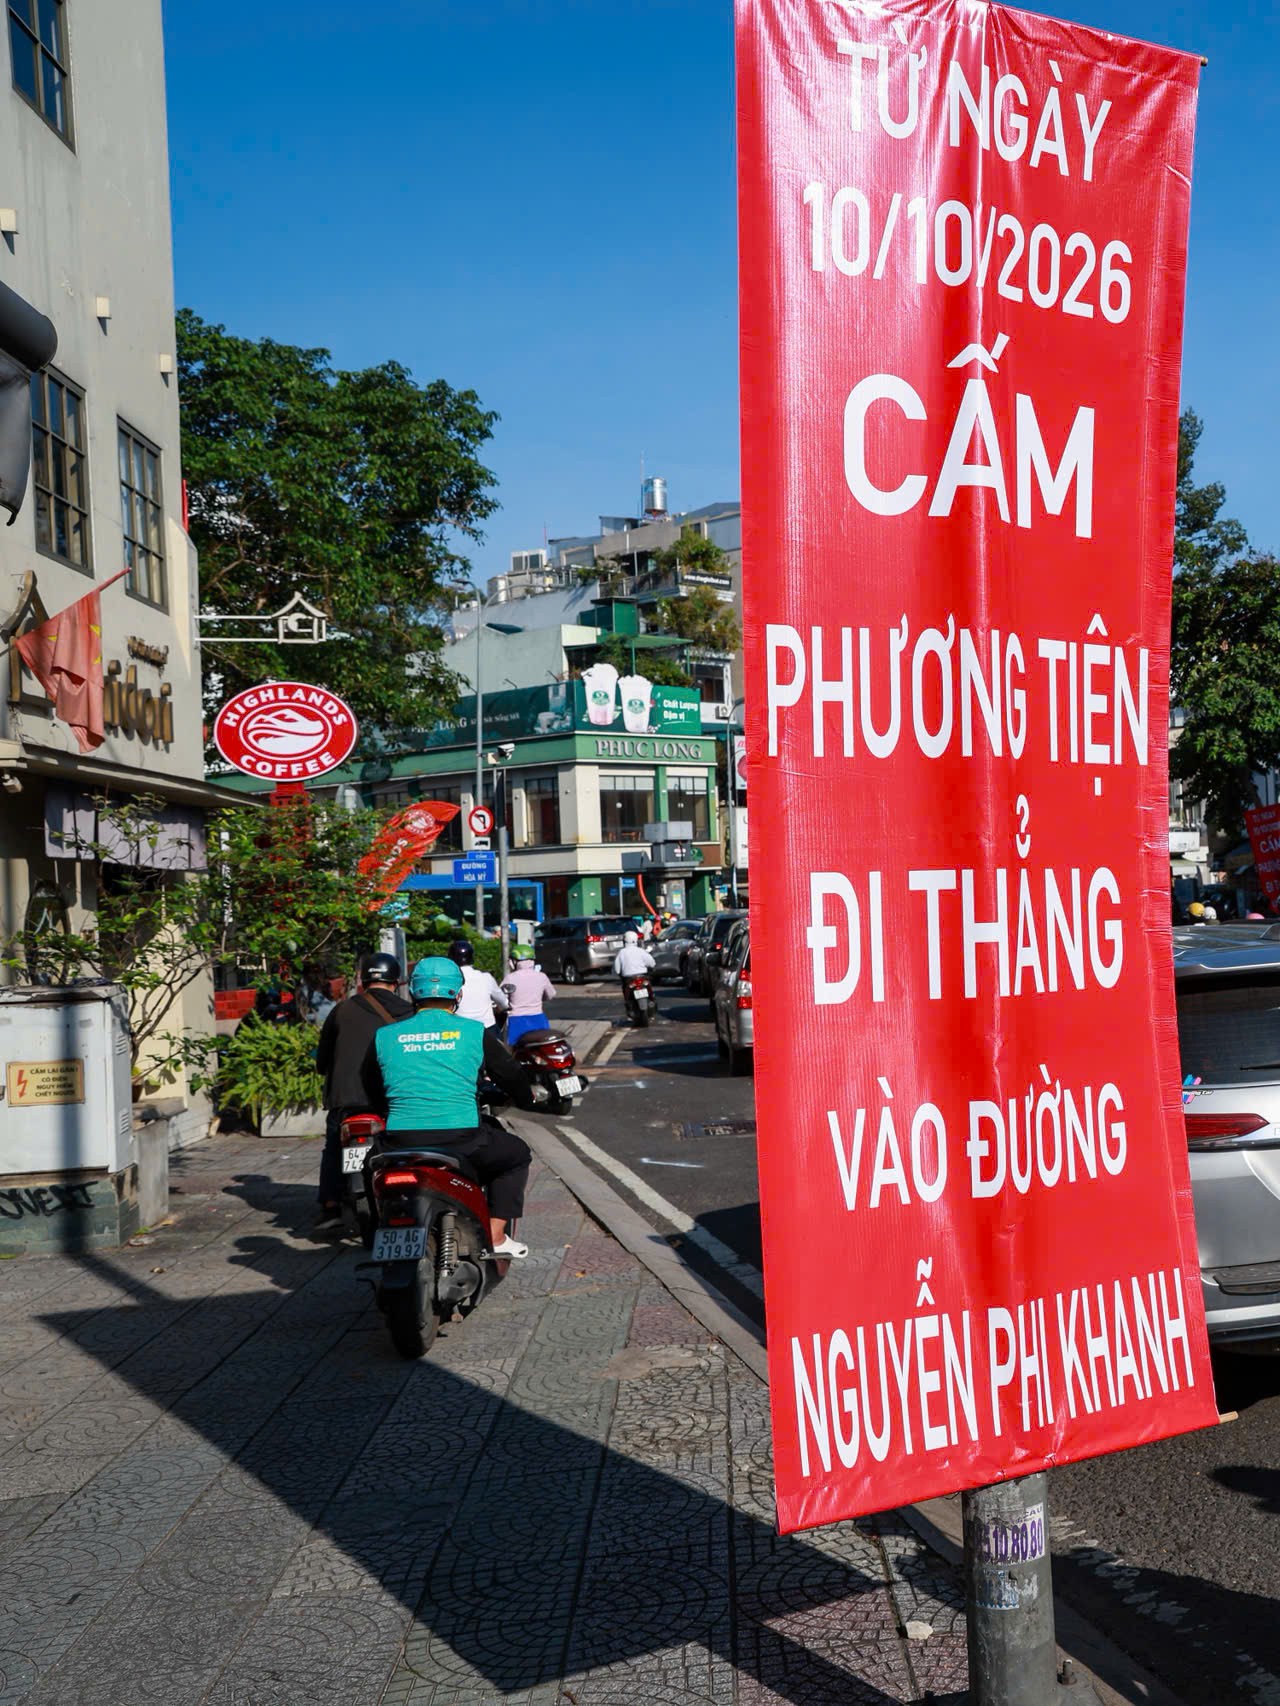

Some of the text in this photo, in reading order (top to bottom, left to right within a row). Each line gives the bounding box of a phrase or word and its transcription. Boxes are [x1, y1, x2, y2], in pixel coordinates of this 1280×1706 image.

[837, 23, 1112, 181] TỪ NGÀY
[803, 181, 1132, 324] 10/10/2026
[844, 334, 1095, 538] CẤM
[223, 687, 347, 727] HIGHLANDS
[240, 751, 336, 777] COFFEE
[652, 742, 702, 760] LONG
[766, 613, 1149, 796] PHƯƠNG TIỆN
[807, 794, 1122, 1005] ĐI THẲNG
[398, 1030, 461, 1043] GREEN SM
[402, 1040, 456, 1053] Xin Chào!
[827, 1064, 1127, 1211] VÀO ĐƯỜNG
[376, 1244, 421, 1260] 319.92
[792, 1256, 1195, 1477] NGUYỄN PHI KHANH
